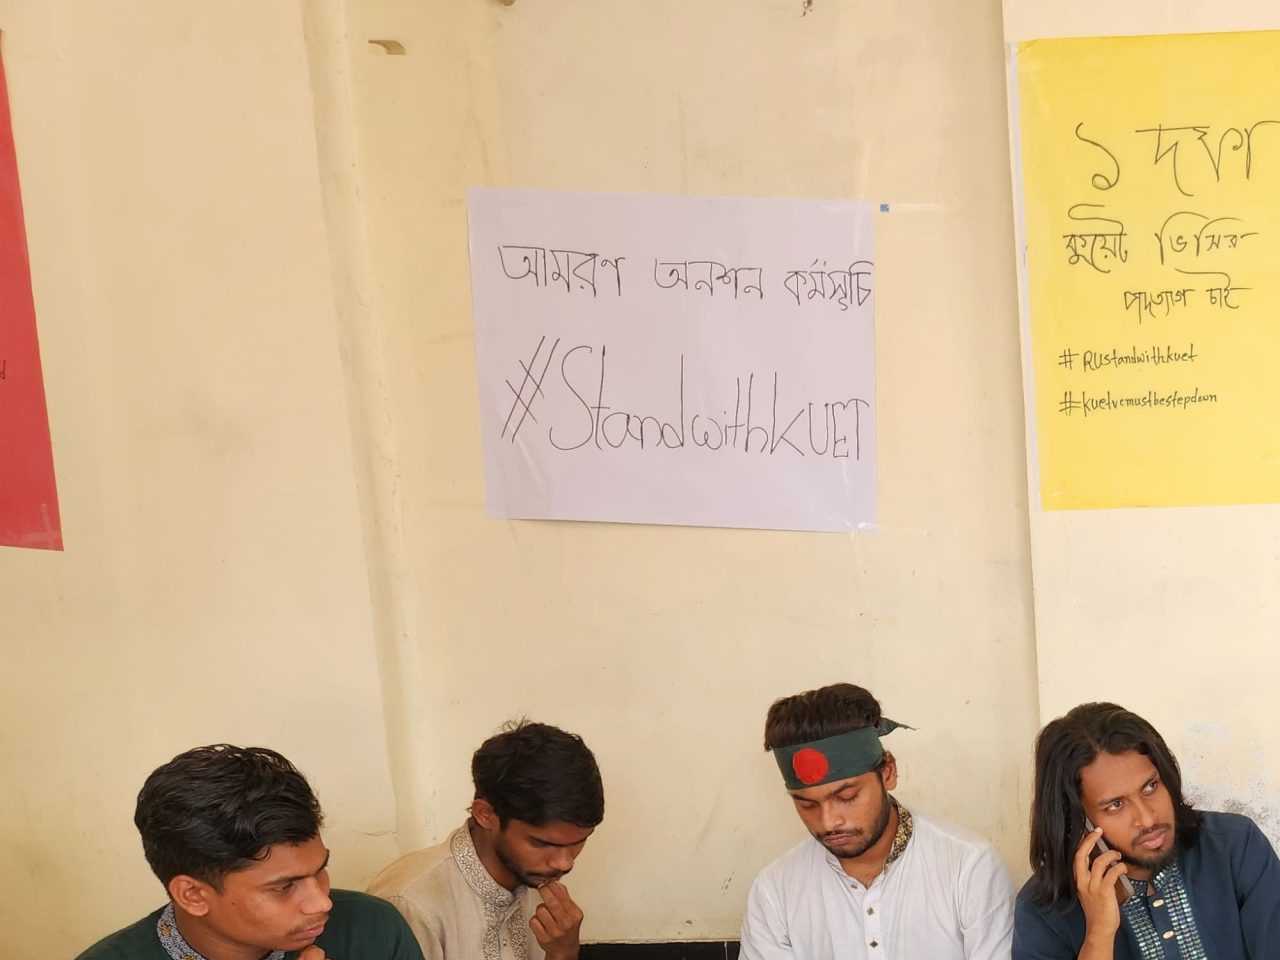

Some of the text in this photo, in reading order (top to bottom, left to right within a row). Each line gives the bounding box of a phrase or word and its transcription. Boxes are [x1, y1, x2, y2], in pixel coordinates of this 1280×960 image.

[1075, 121, 1121, 191] ১
[498, 245, 626, 298] আমরণ
[654, 258, 763, 300] অনশন
